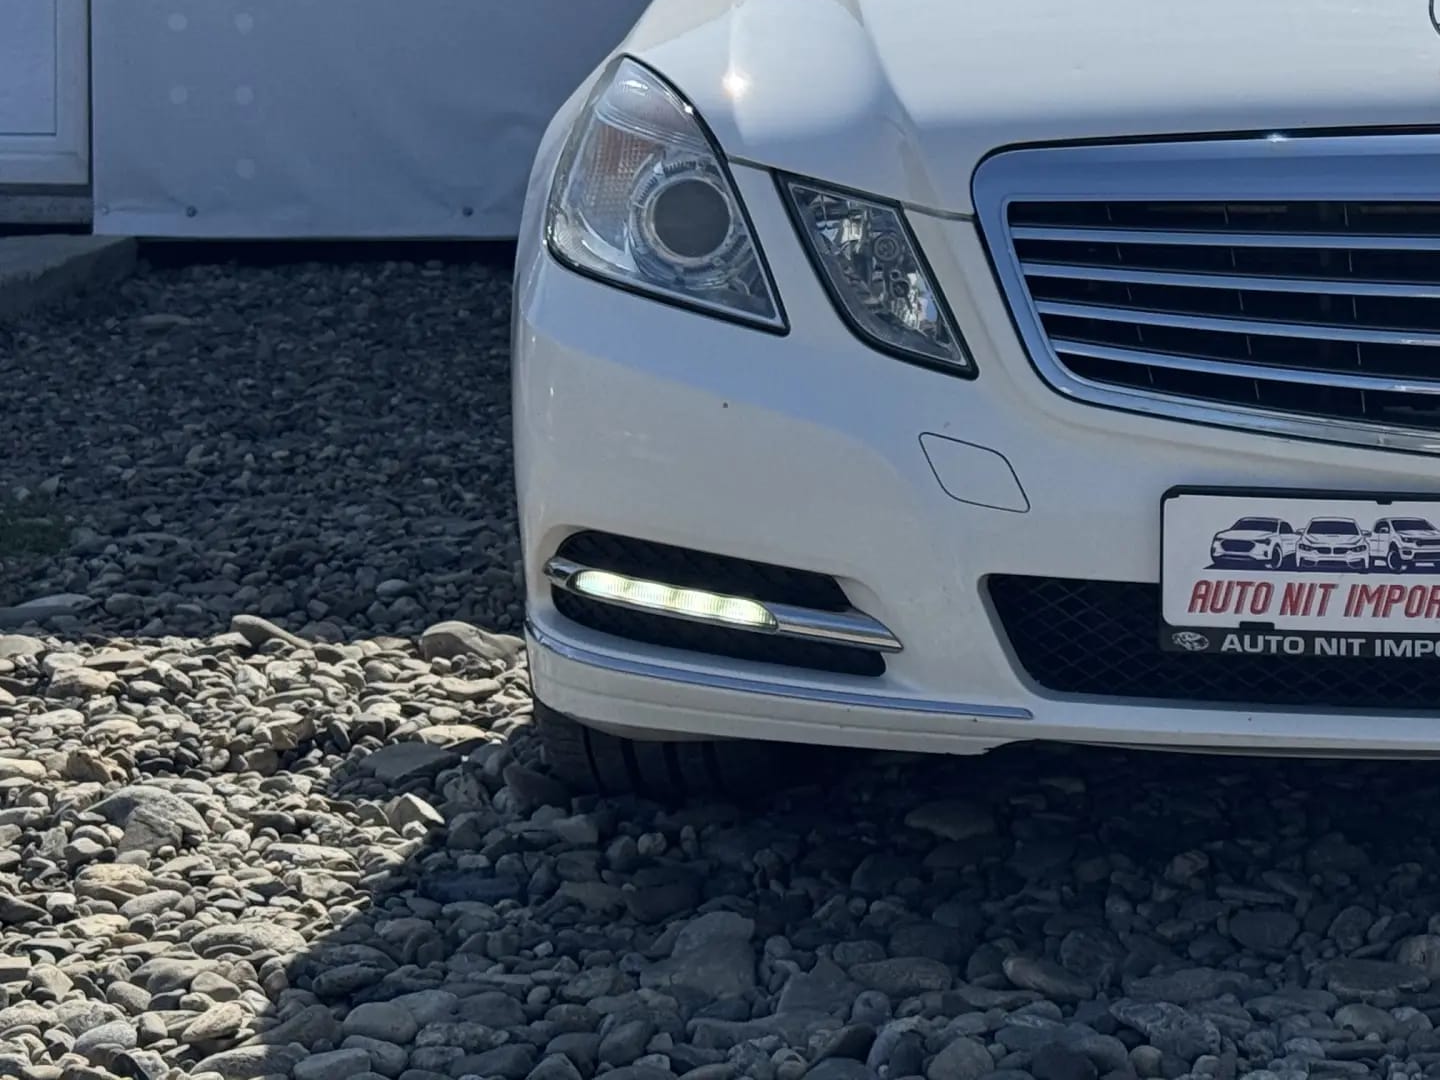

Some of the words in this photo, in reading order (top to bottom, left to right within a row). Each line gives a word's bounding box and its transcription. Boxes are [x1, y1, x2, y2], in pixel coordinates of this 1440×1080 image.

[1187, 579, 1275, 616] AUTO
[1279, 582, 1339, 617] NIT
[1220, 633, 1305, 656] AUTO
[1314, 636, 1367, 658] NIT
